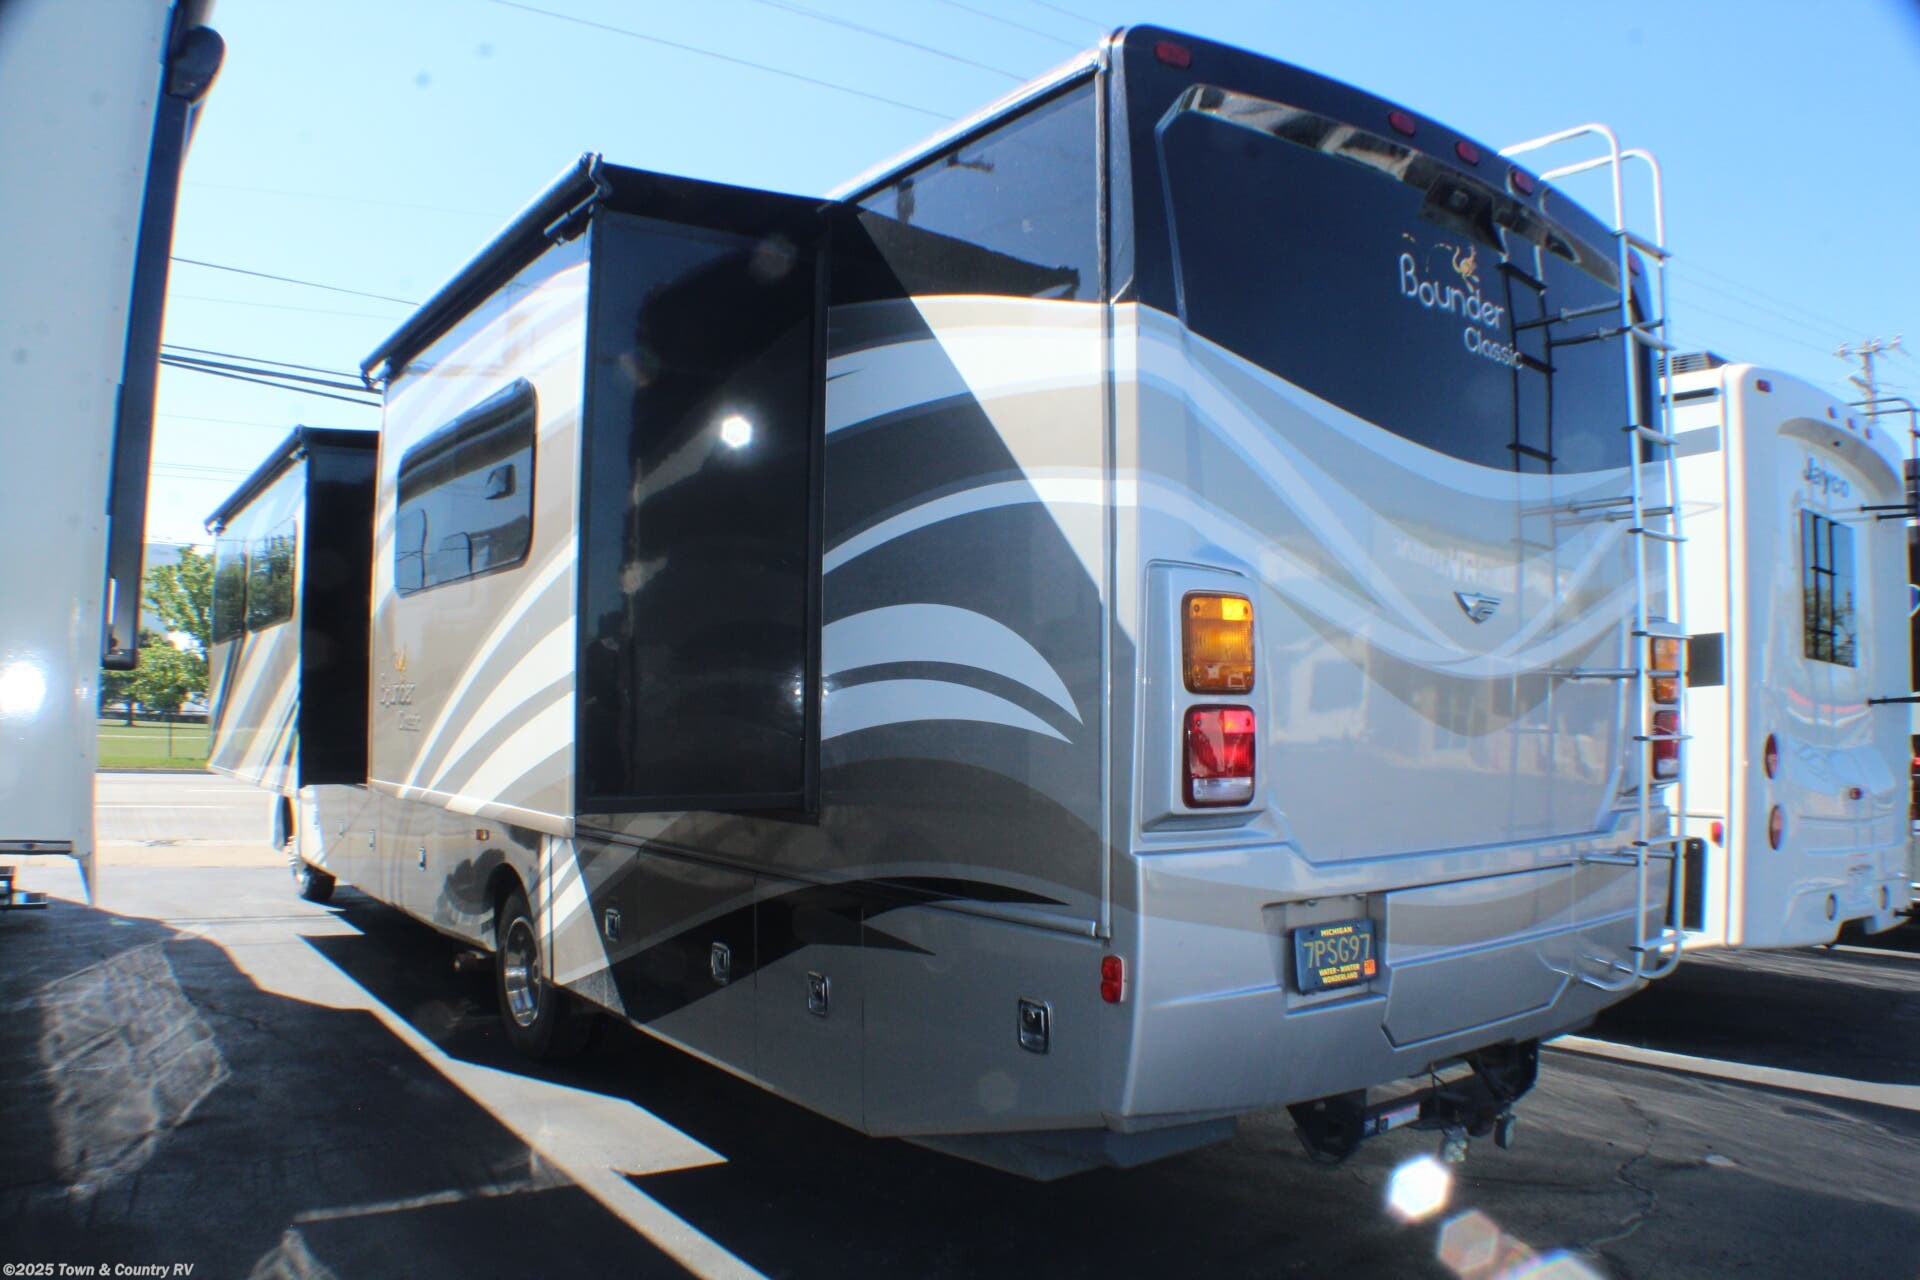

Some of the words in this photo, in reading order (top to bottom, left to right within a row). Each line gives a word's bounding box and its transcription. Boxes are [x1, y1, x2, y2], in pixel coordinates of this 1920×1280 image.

[1400, 253, 1504, 328] Bounder
[1464, 326, 1523, 369] Classic
[1803, 457, 1849, 497] Jayco
[1303, 933, 1370, 969] 7PSG97
[1320, 926, 1353, 937] MICHIGAN
